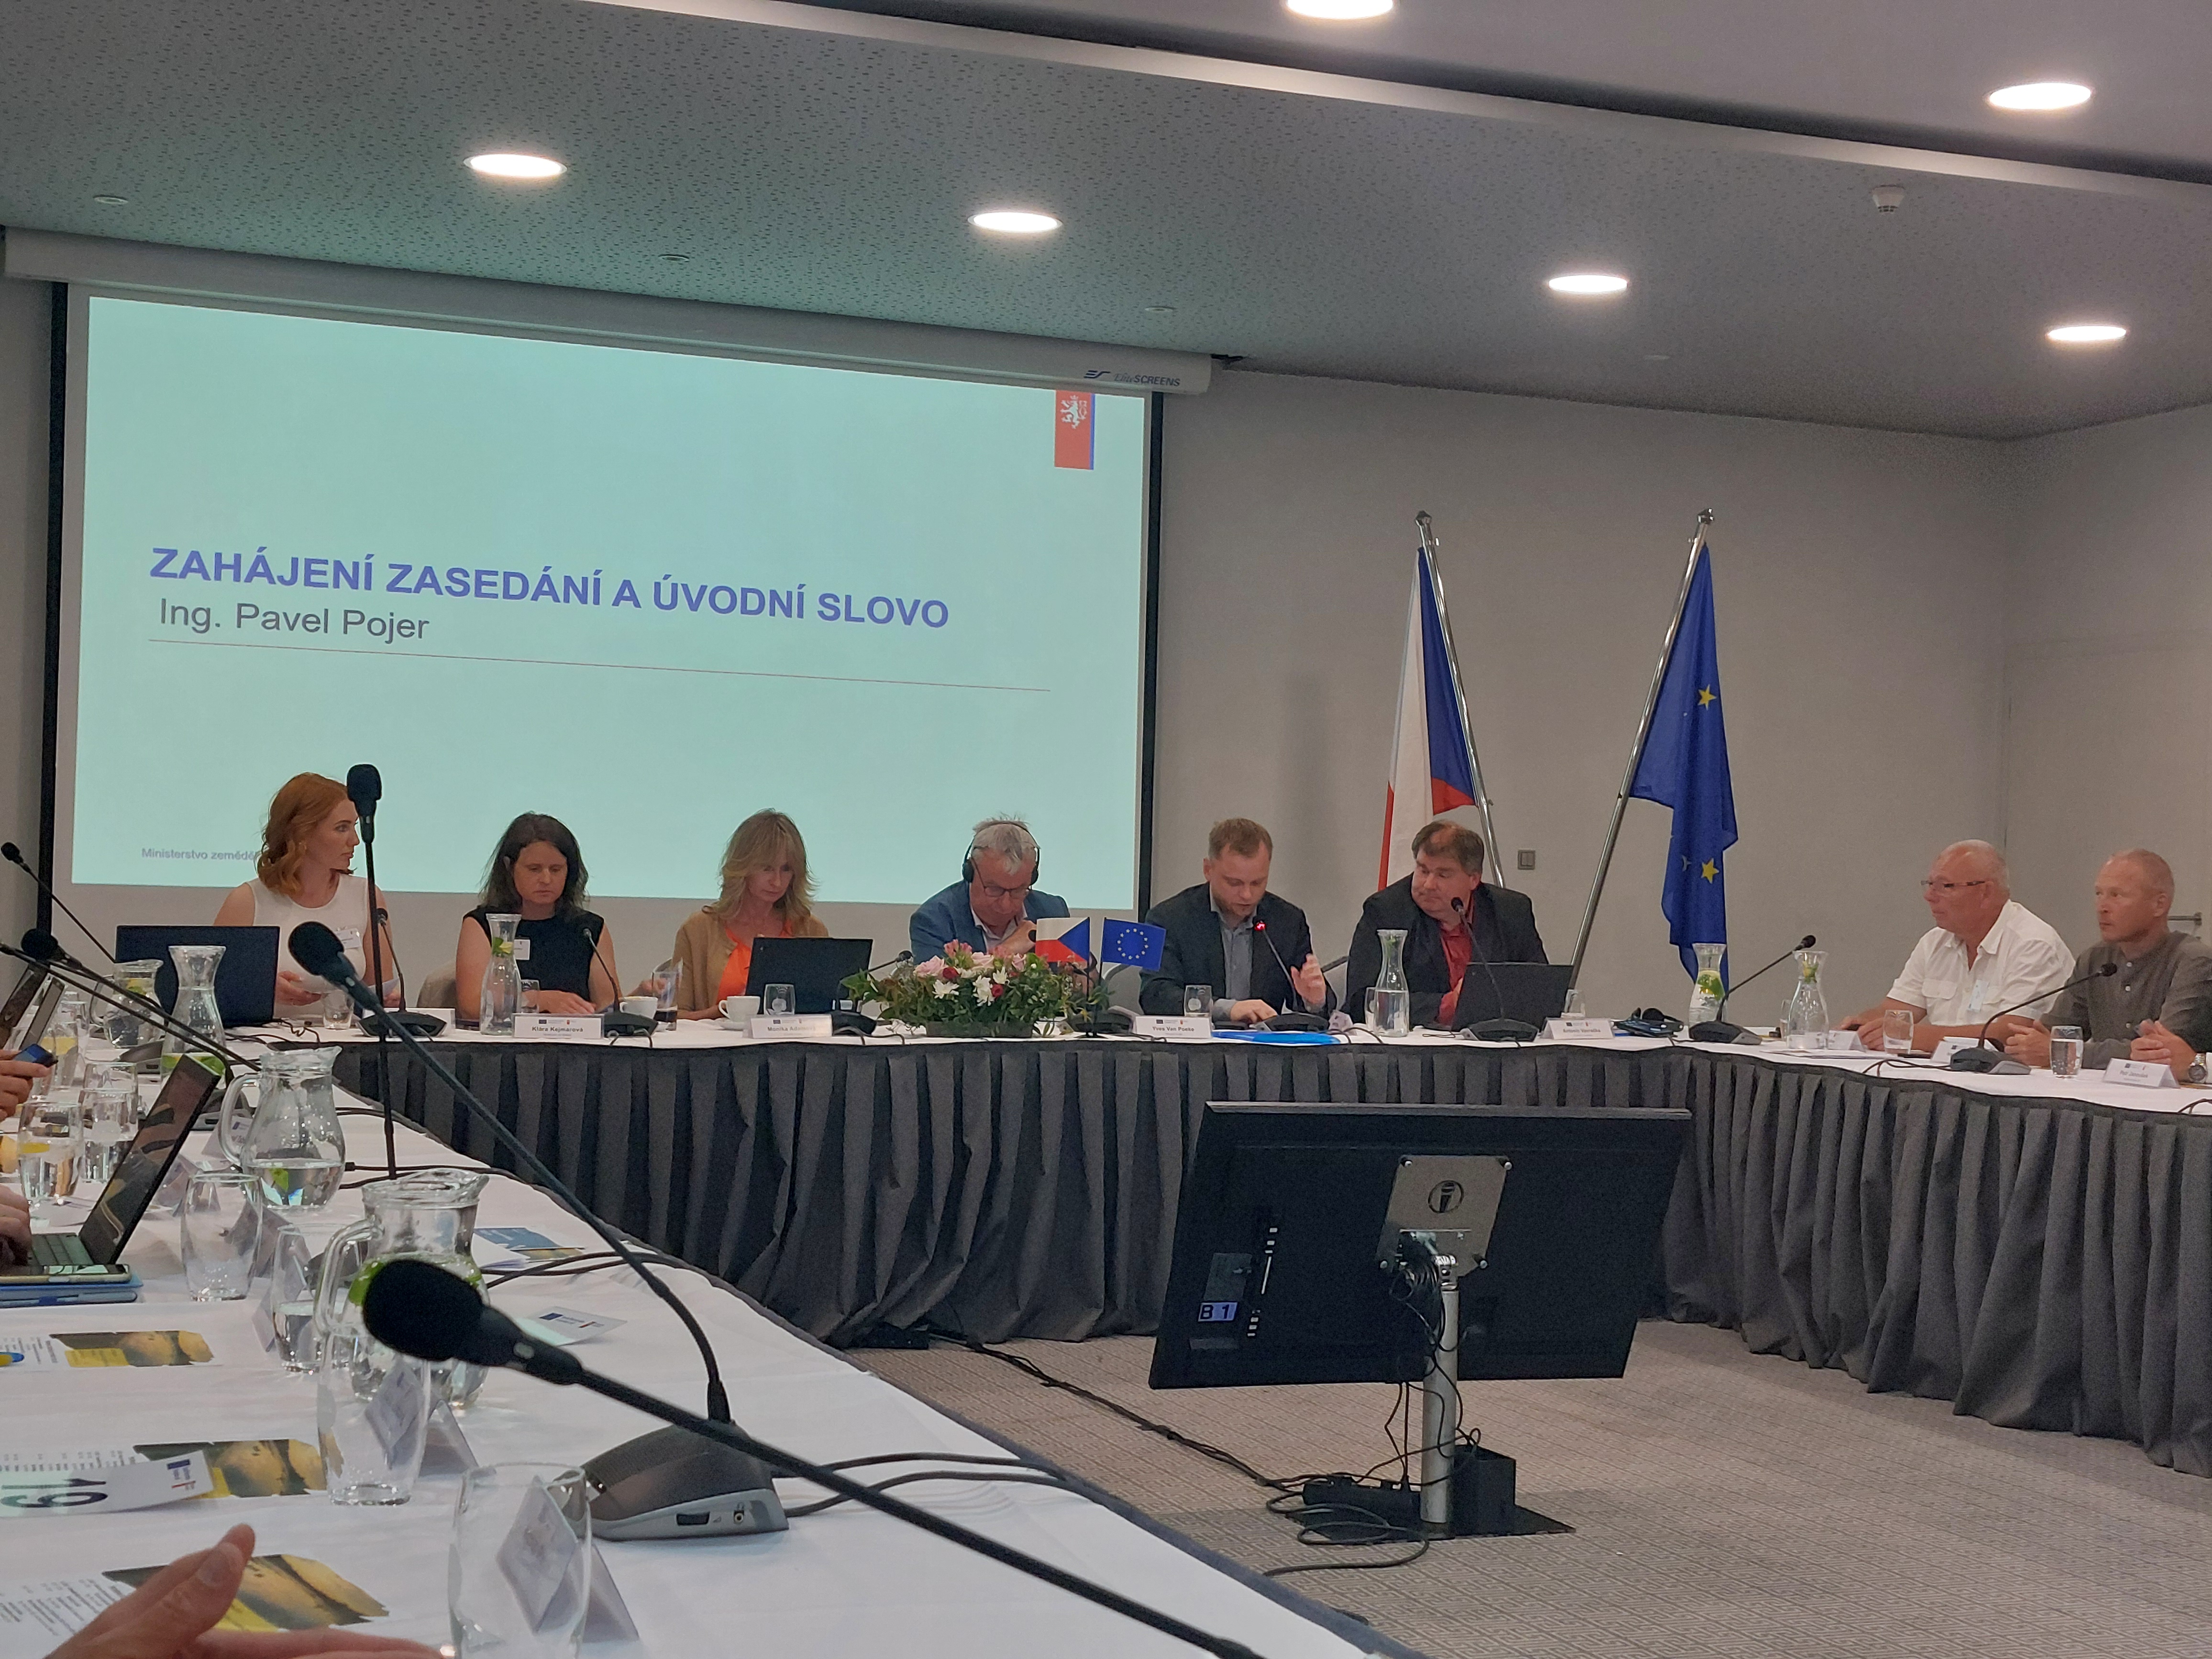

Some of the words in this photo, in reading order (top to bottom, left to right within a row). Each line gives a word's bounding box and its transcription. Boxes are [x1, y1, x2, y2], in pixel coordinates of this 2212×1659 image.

[151, 547, 375, 591] ZAHÁJENÍ
[387, 564, 603, 606] ZASEDÁNÍ
[612, 579, 641, 609] A
[653, 575, 806, 619] ÚVODNÍ
[817, 593, 949, 628] SLOVO
[160, 598, 221, 634] Ing.
[237, 603, 329, 634] Pavel
[343, 610, 430, 644] Pojer
[143, 849, 208, 860] Ministerstvo
